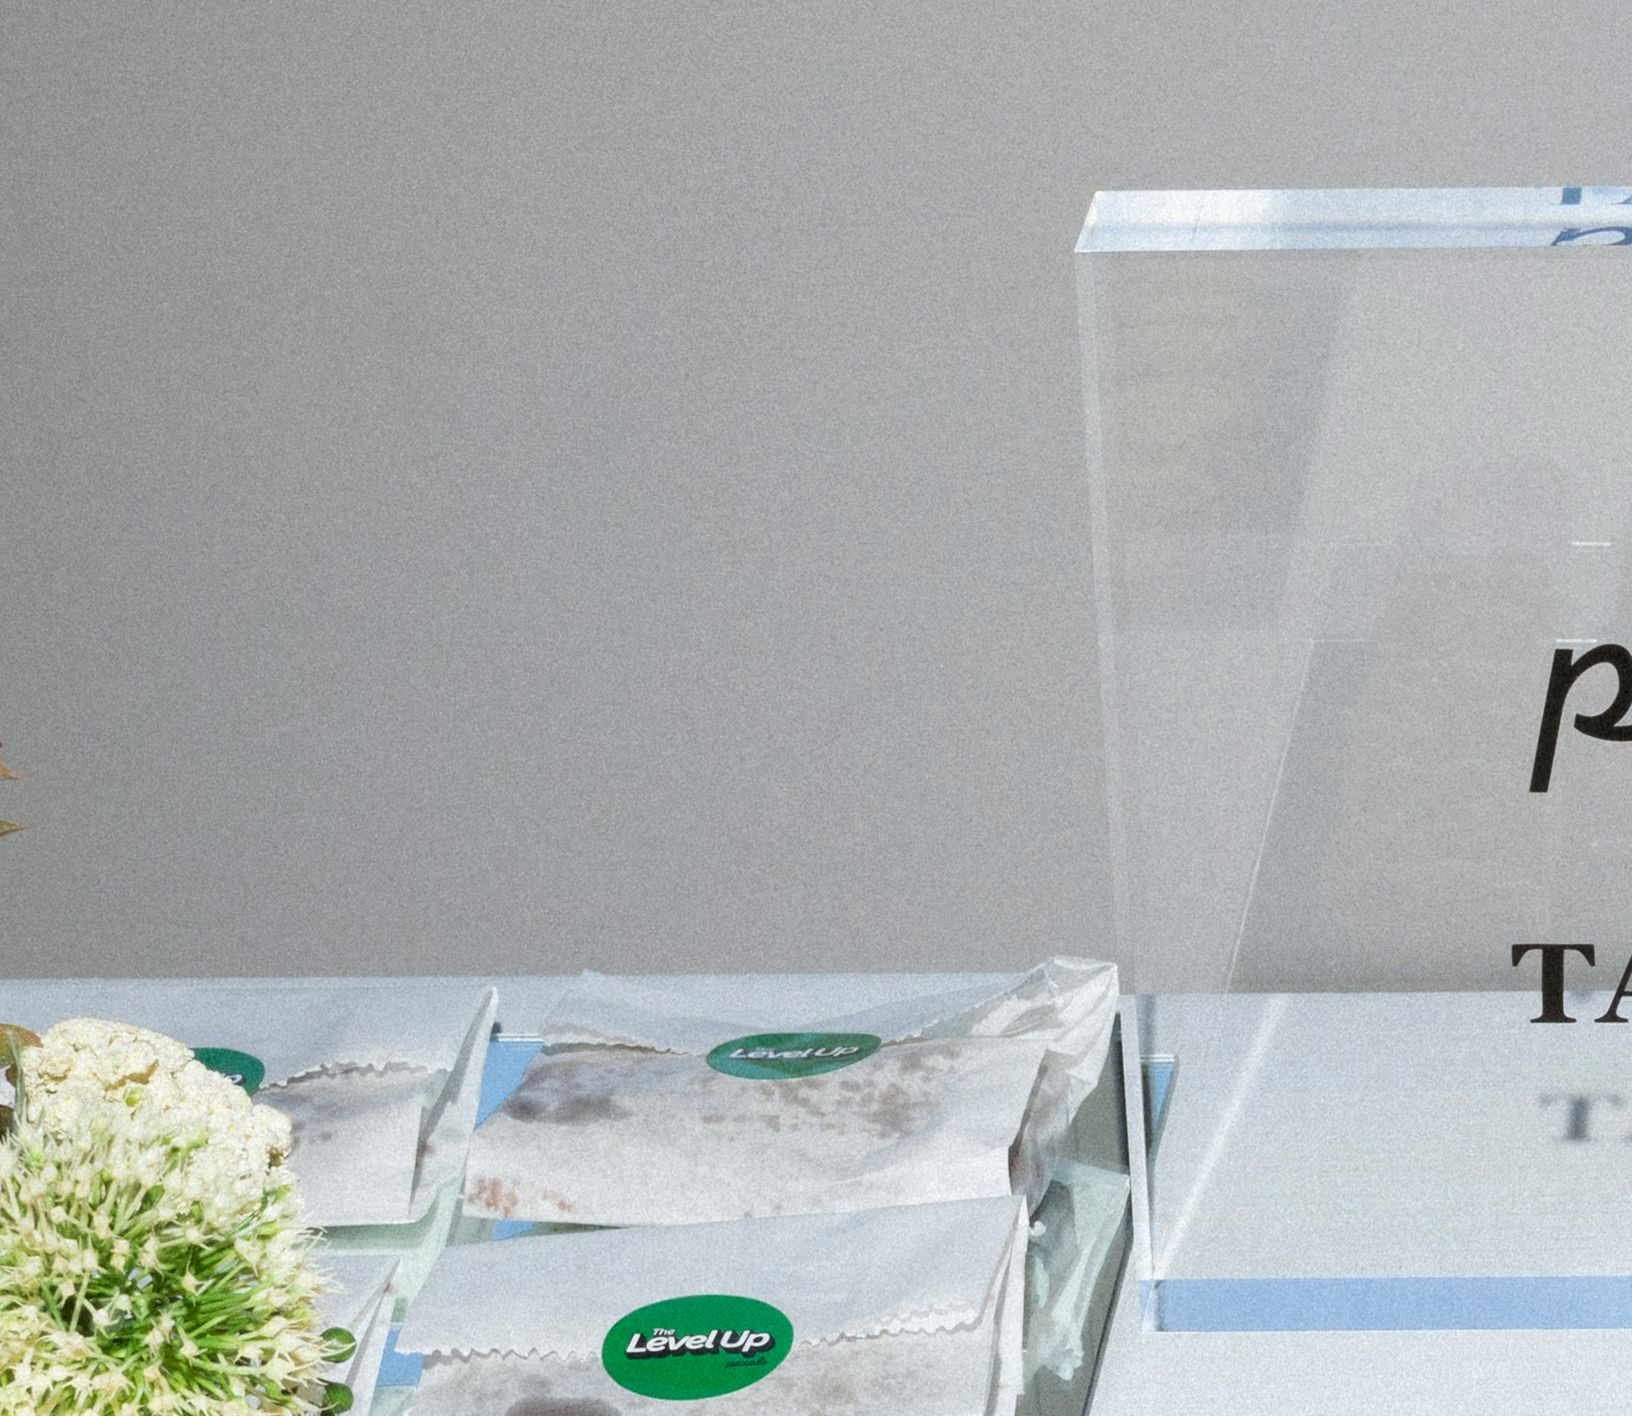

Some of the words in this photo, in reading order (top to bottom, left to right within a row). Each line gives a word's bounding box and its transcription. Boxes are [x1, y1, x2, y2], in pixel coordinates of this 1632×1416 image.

[728, 1046, 812, 1061] Level
[652, 1327, 676, 1337] The
[625, 1329, 719, 1356] Level
[719, 1329, 773, 1354] Up
